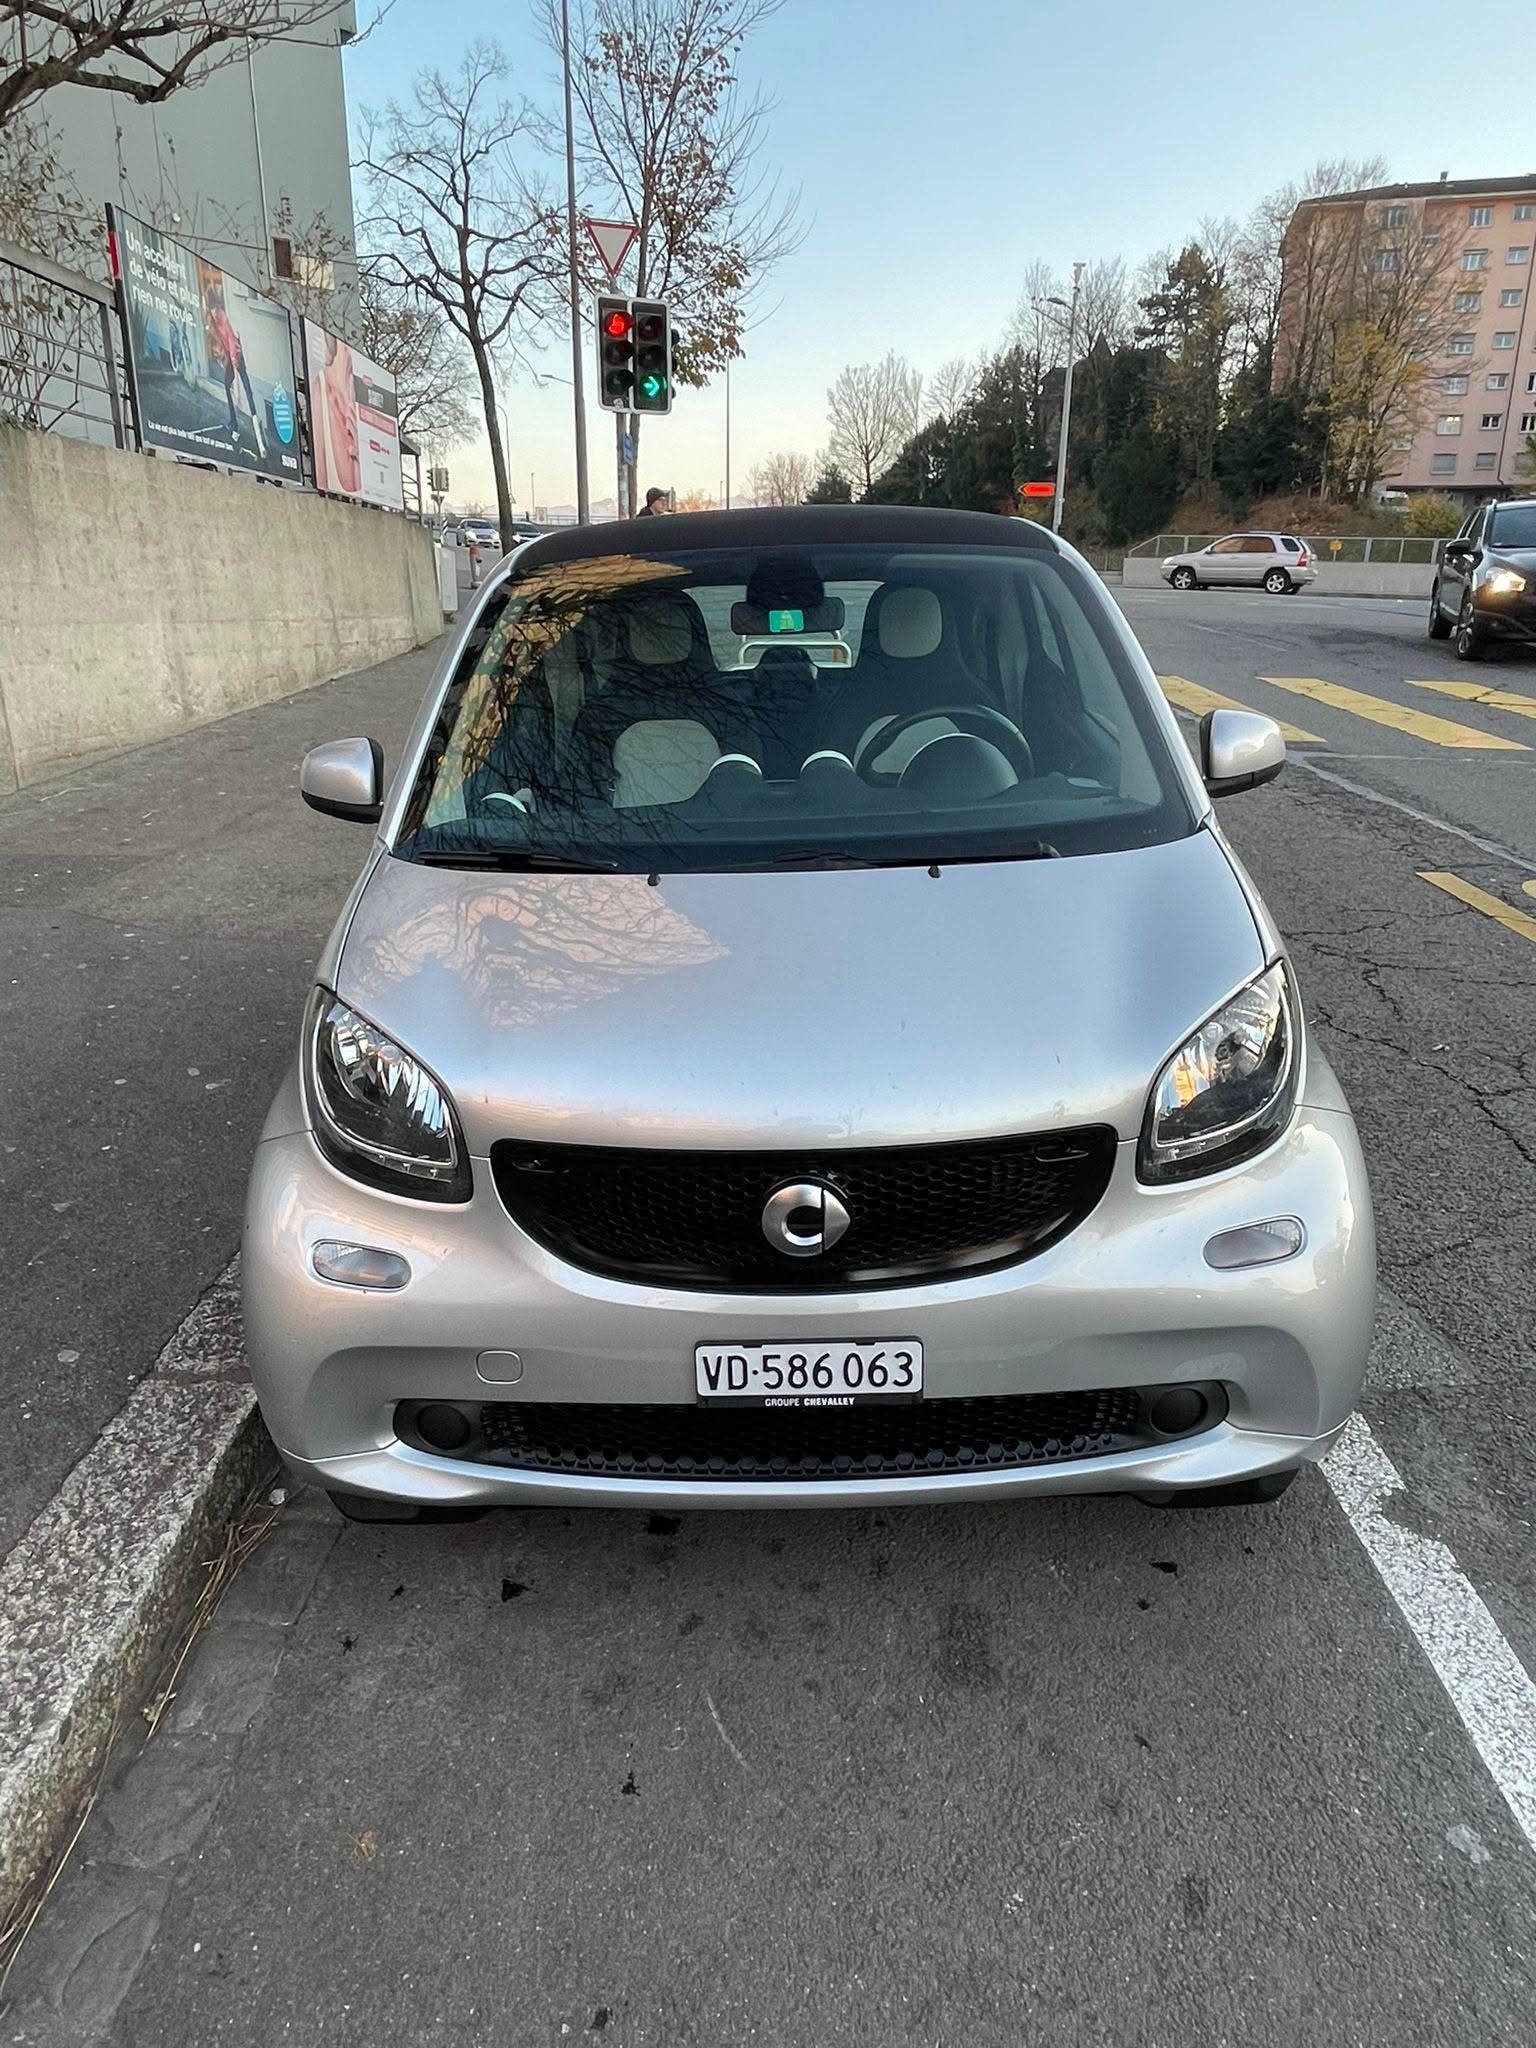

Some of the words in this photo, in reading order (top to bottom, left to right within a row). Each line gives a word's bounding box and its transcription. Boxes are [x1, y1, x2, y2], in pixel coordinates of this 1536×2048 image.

[125, 229, 142, 256] Un
[144, 244, 187, 281] accident
[130, 257, 144, 279] de
[144, 267, 167, 291] vélo
[168, 280, 179, 299] et
[180, 285, 200, 308] plus
[133, 282, 154, 308] rien
[155, 296, 168, 314] ne
[765, 1397, 800, 1408] GROUPE
[804, 1396, 856, 1407] CHEVALLEY
